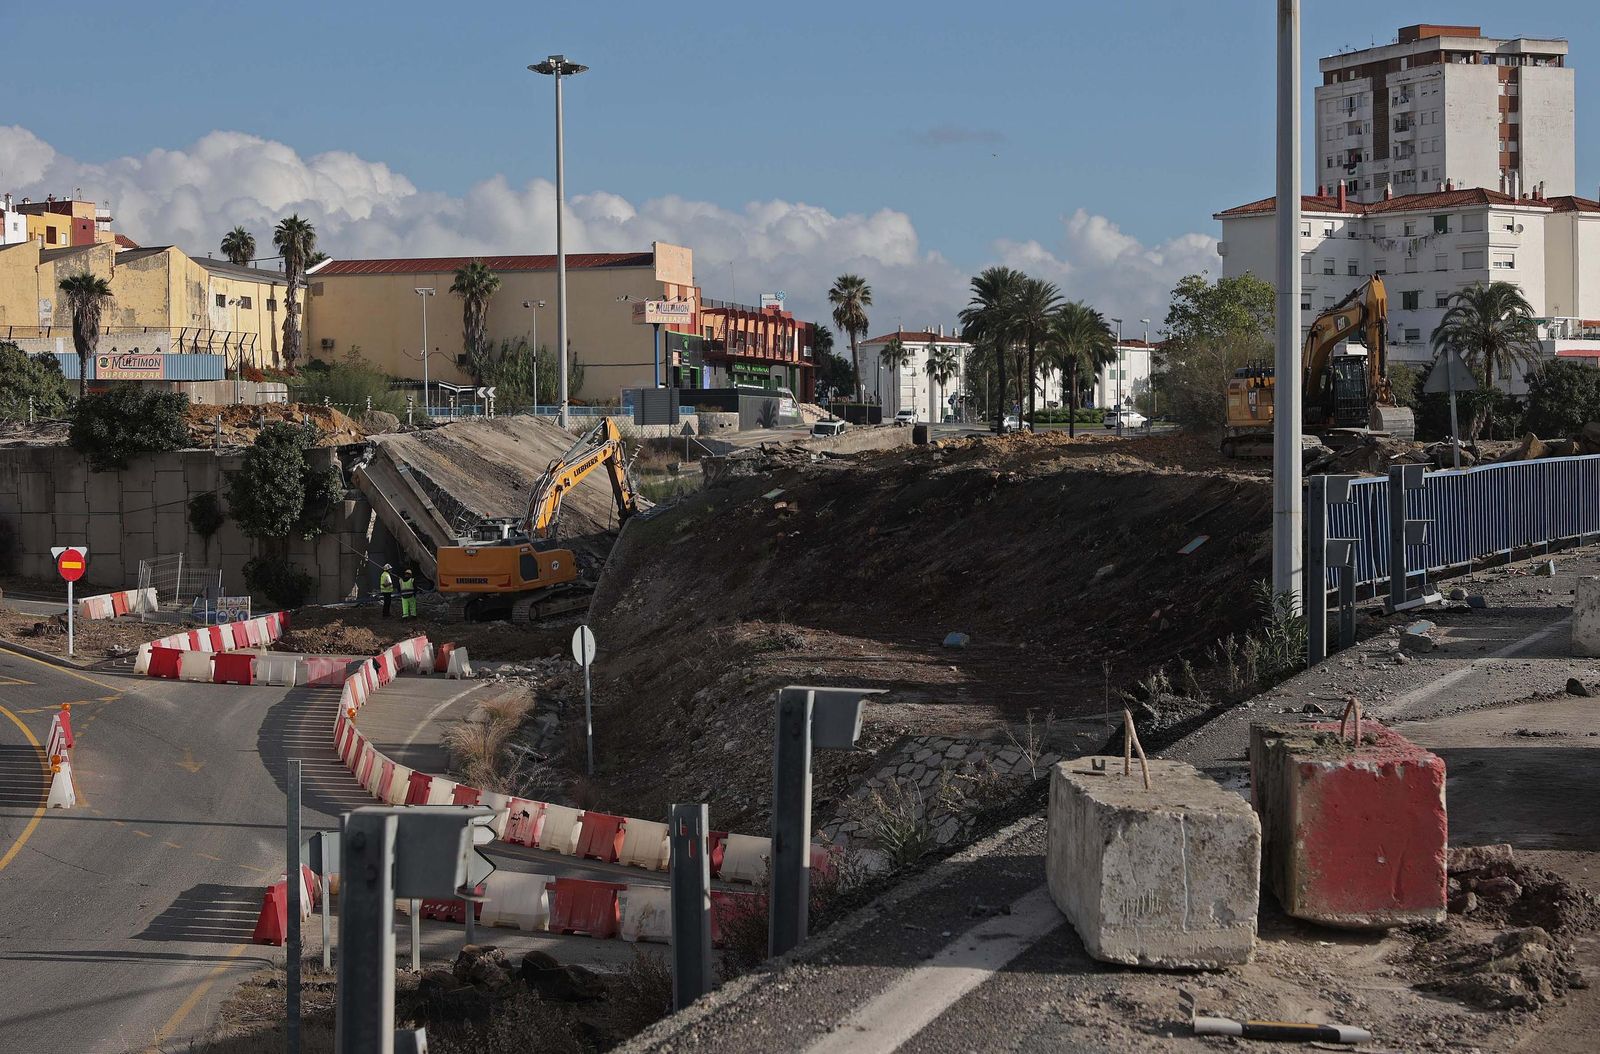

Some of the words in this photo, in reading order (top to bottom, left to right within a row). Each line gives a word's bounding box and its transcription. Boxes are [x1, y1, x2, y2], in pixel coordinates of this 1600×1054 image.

[1337, 316, 1346, 331] CAT
[111, 356, 161, 370] MULTIMON
[1248, 391, 1257, 405] CAT
[573, 455, 599, 477] LIEBHERR
[456, 577, 488, 585] LIEBHERR
